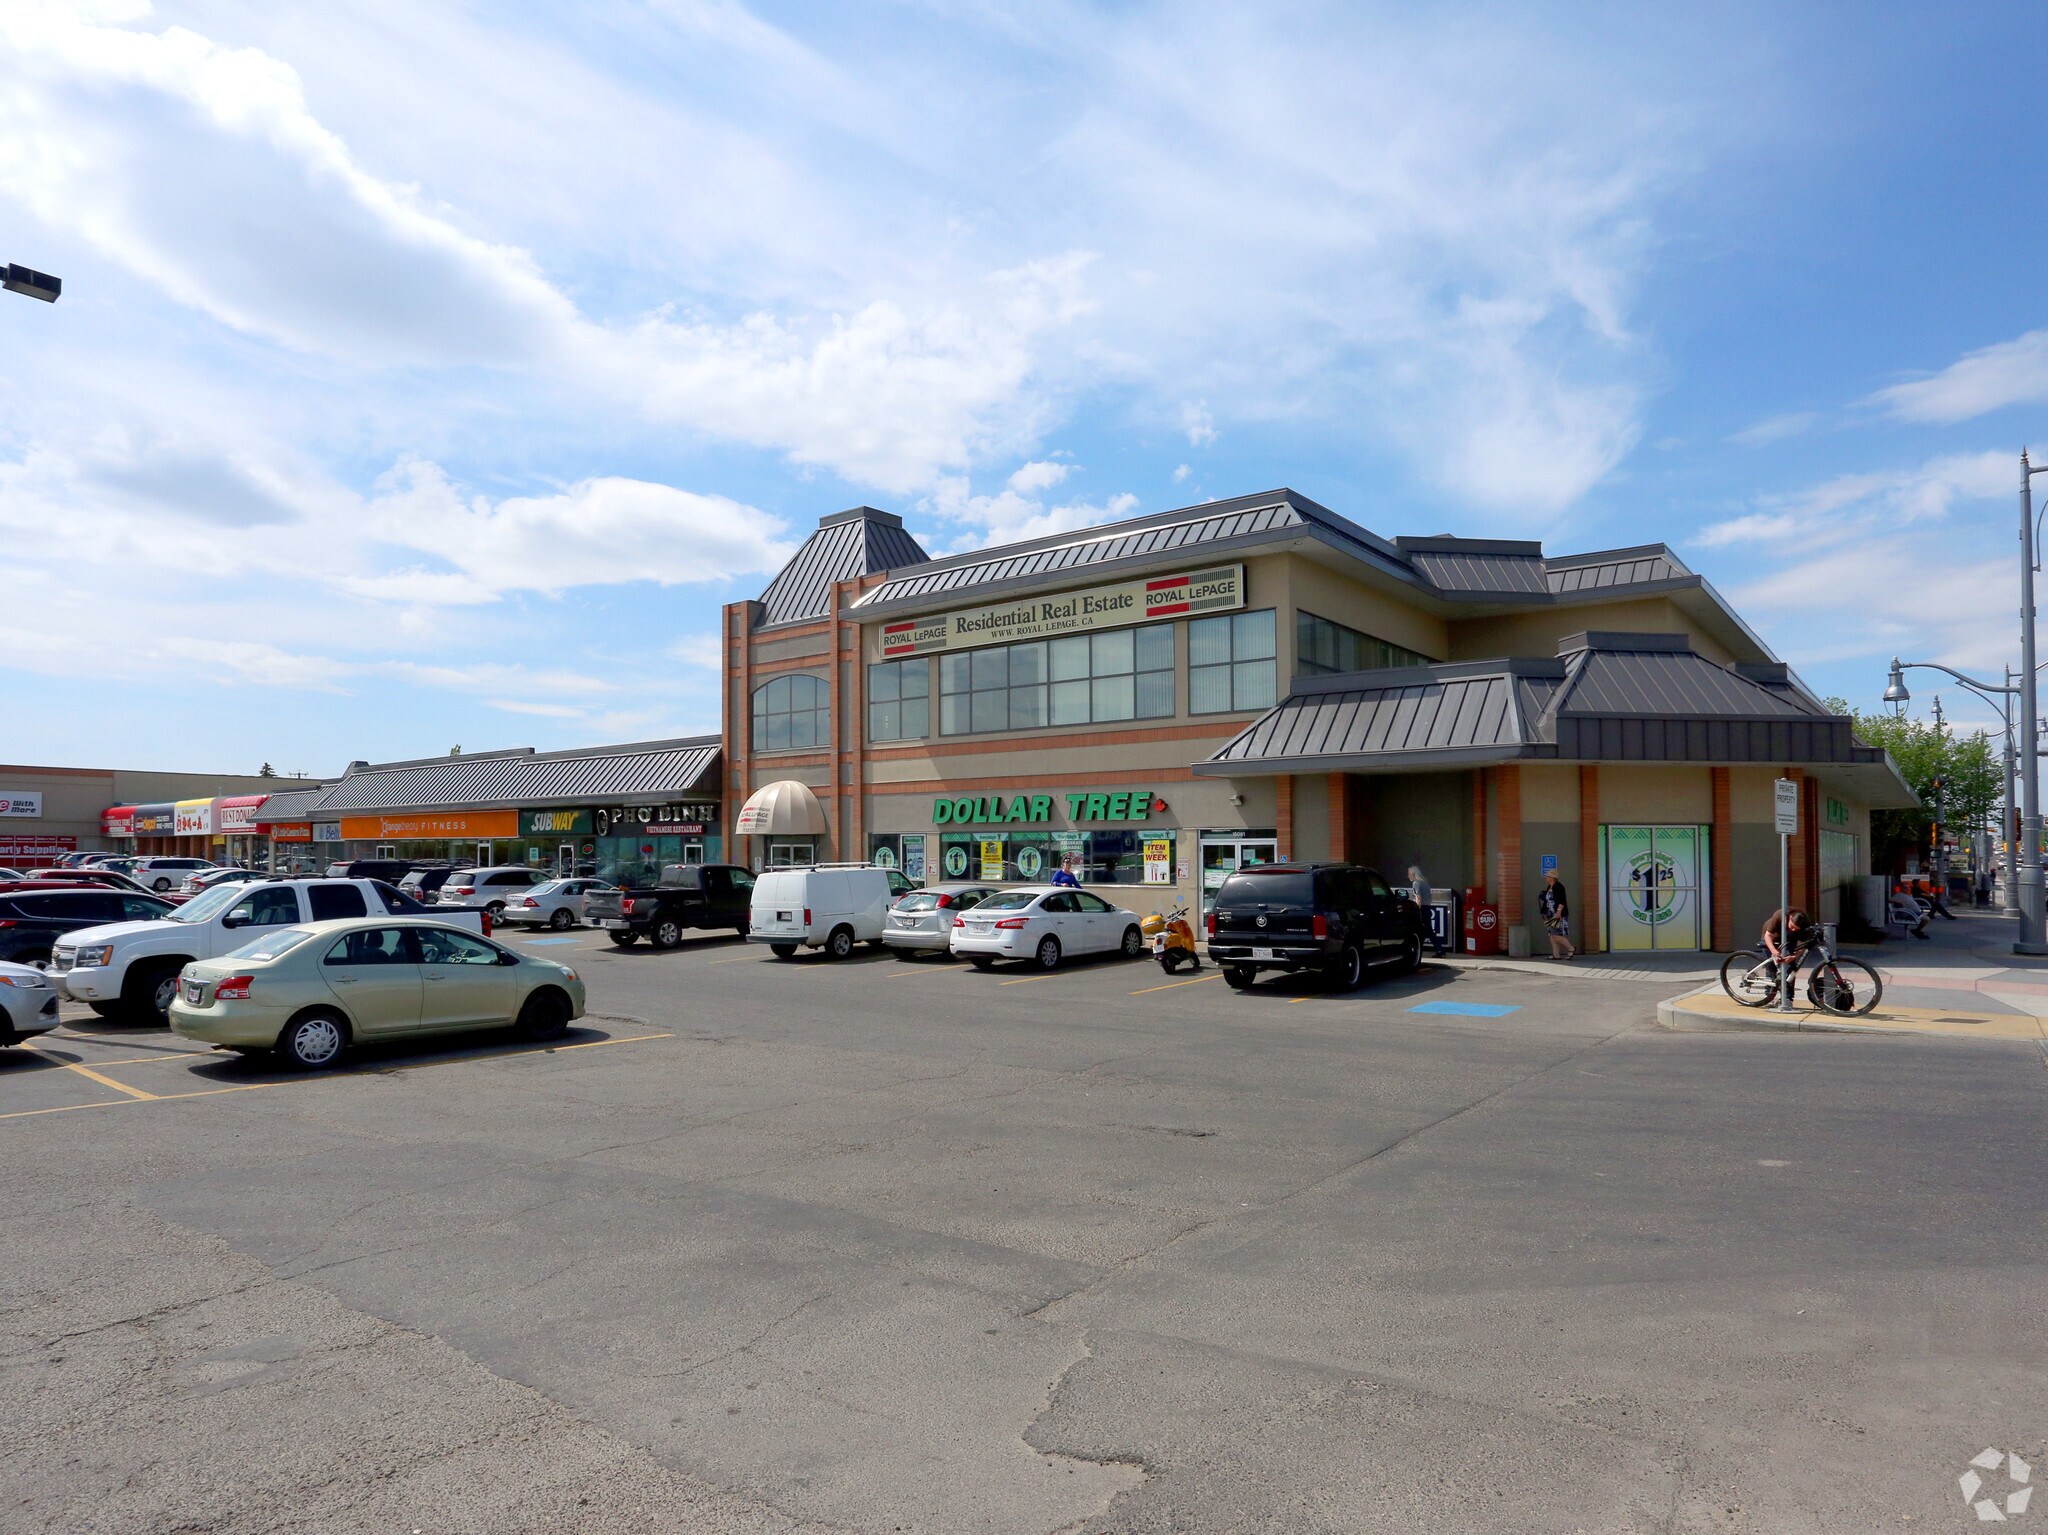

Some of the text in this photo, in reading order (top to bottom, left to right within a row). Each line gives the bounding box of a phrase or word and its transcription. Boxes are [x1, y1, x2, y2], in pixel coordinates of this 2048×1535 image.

[1146, 581, 1235, 607] ROYAL LePAGE
[956, 593, 1134, 634] Residential Real Estate
[991, 629, 1015, 639] WWW.
[1017, 626, 1043, 635] ROYAL
[1081, 617, 1094, 625] CA
[883, 626, 947, 646] ROYAL LePAGE
[1779, 784, 1794, 794] PRIVATE
[1777, 794, 1796, 804] PROPERTY
[659, 805, 715, 822] BINH
[932, 791, 1153, 824] DOLLAR TREE
[222, 810, 235, 823] BEST
[531, 810, 580, 831] SUBWAY
[421, 821, 467, 830] FITNESS
[646, 825, 702, 834] VIETNAMESE RESTAURANT
[0, 845, 68, 854] arty Supplies
[1479, 916, 1495, 924] SUN
[1632, 909, 1648, 922] OR
